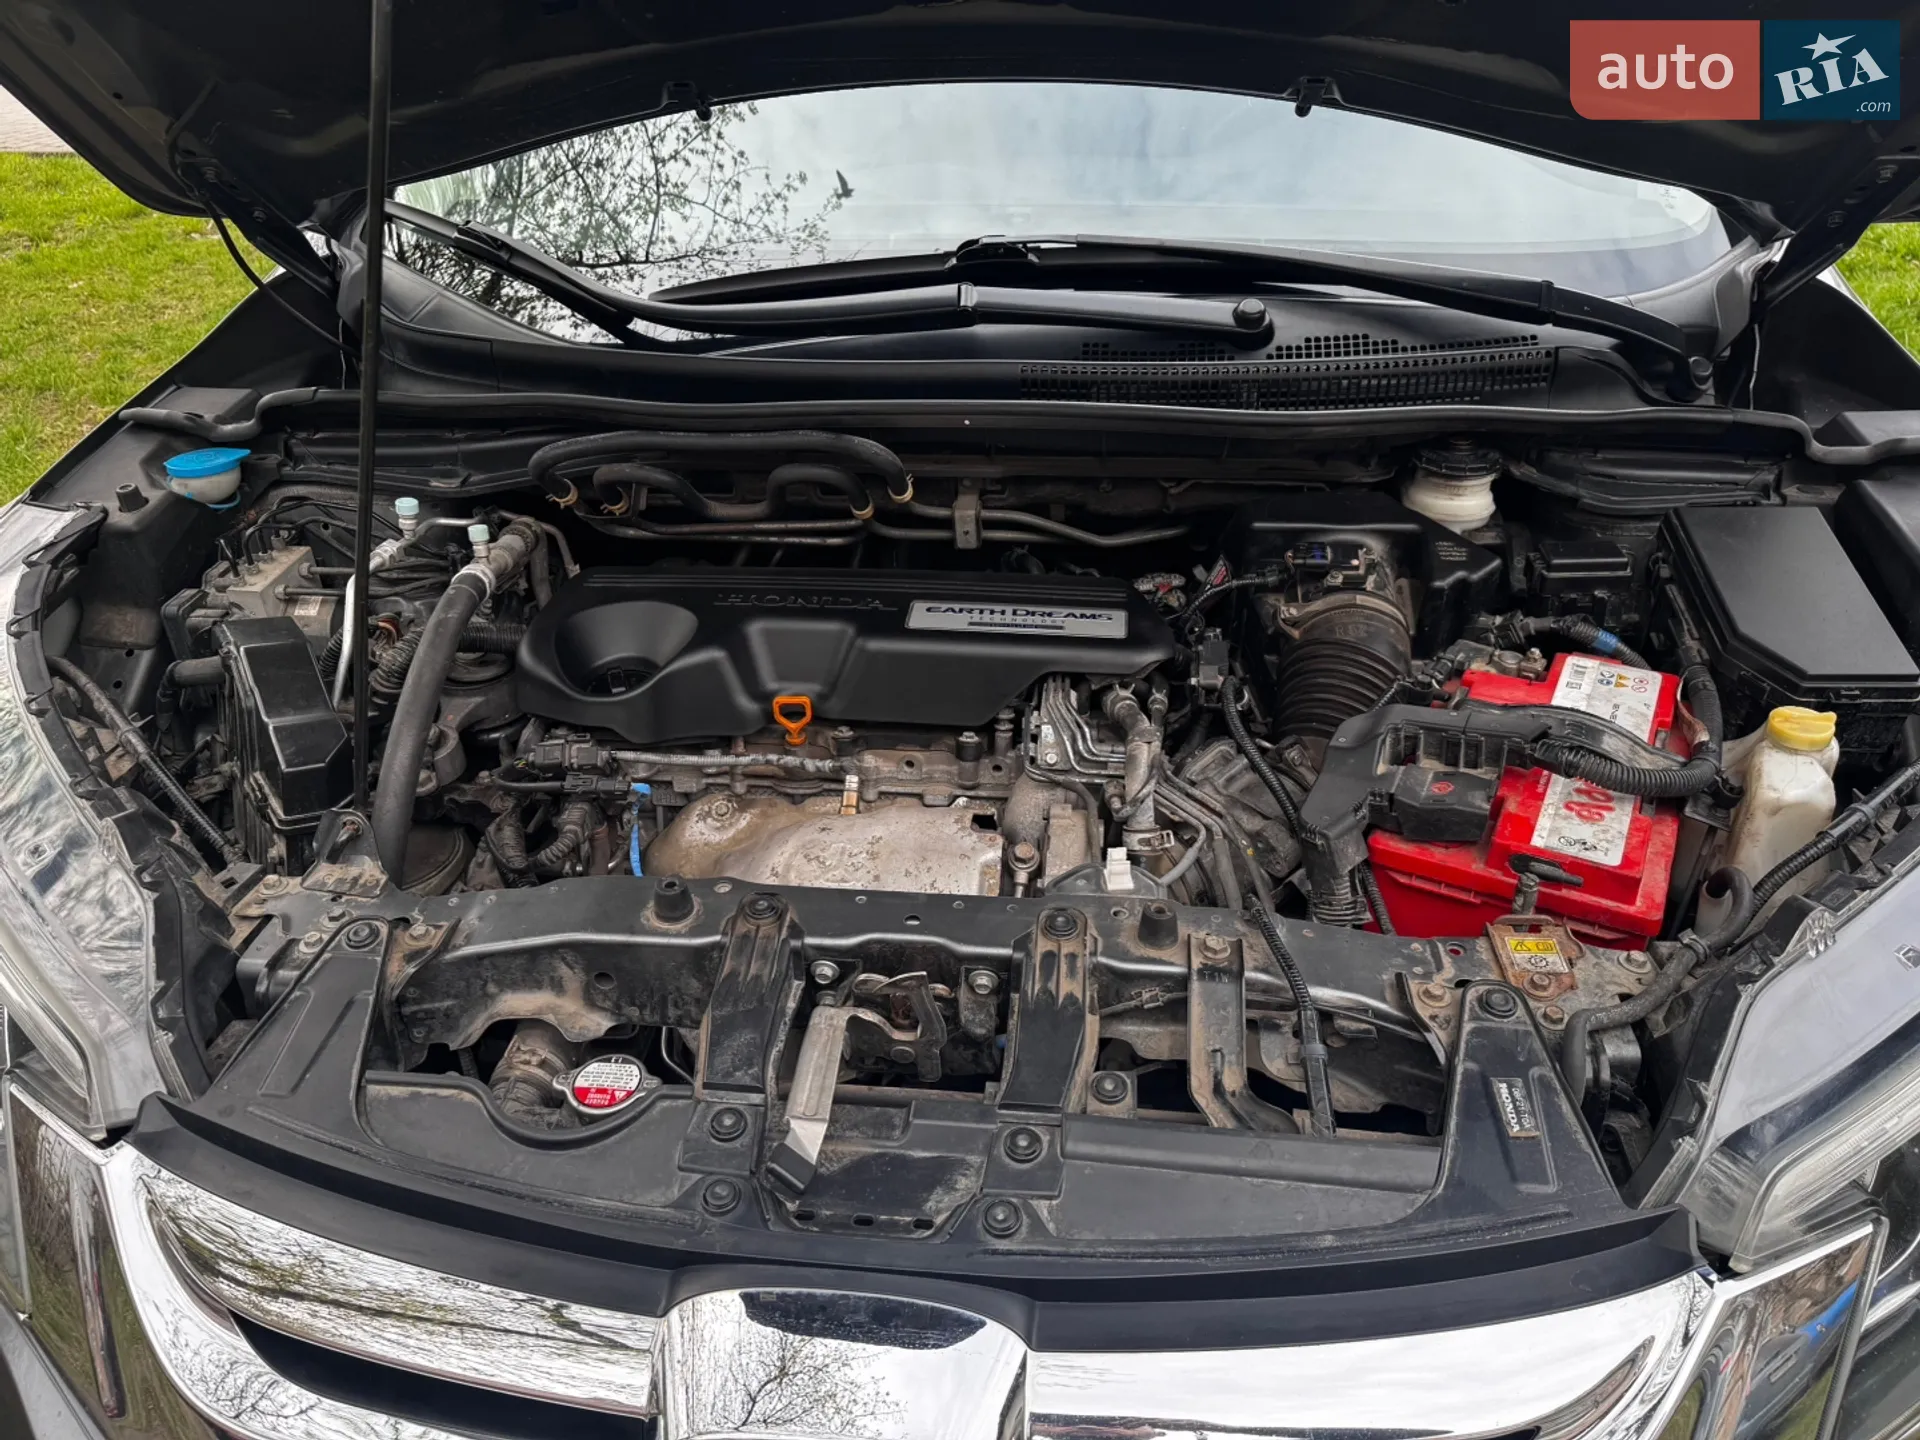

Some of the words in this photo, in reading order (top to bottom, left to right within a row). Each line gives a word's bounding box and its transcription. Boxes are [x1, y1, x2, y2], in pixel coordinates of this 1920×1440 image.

[713, 593, 899, 611] HONDA
[925, 606, 1006, 616] EARTH
[1011, 608, 1114, 621] DREAMS
[969, 616, 1067, 625] TECHNOLOGY
[1498, 1082, 1520, 1133] HONDA
